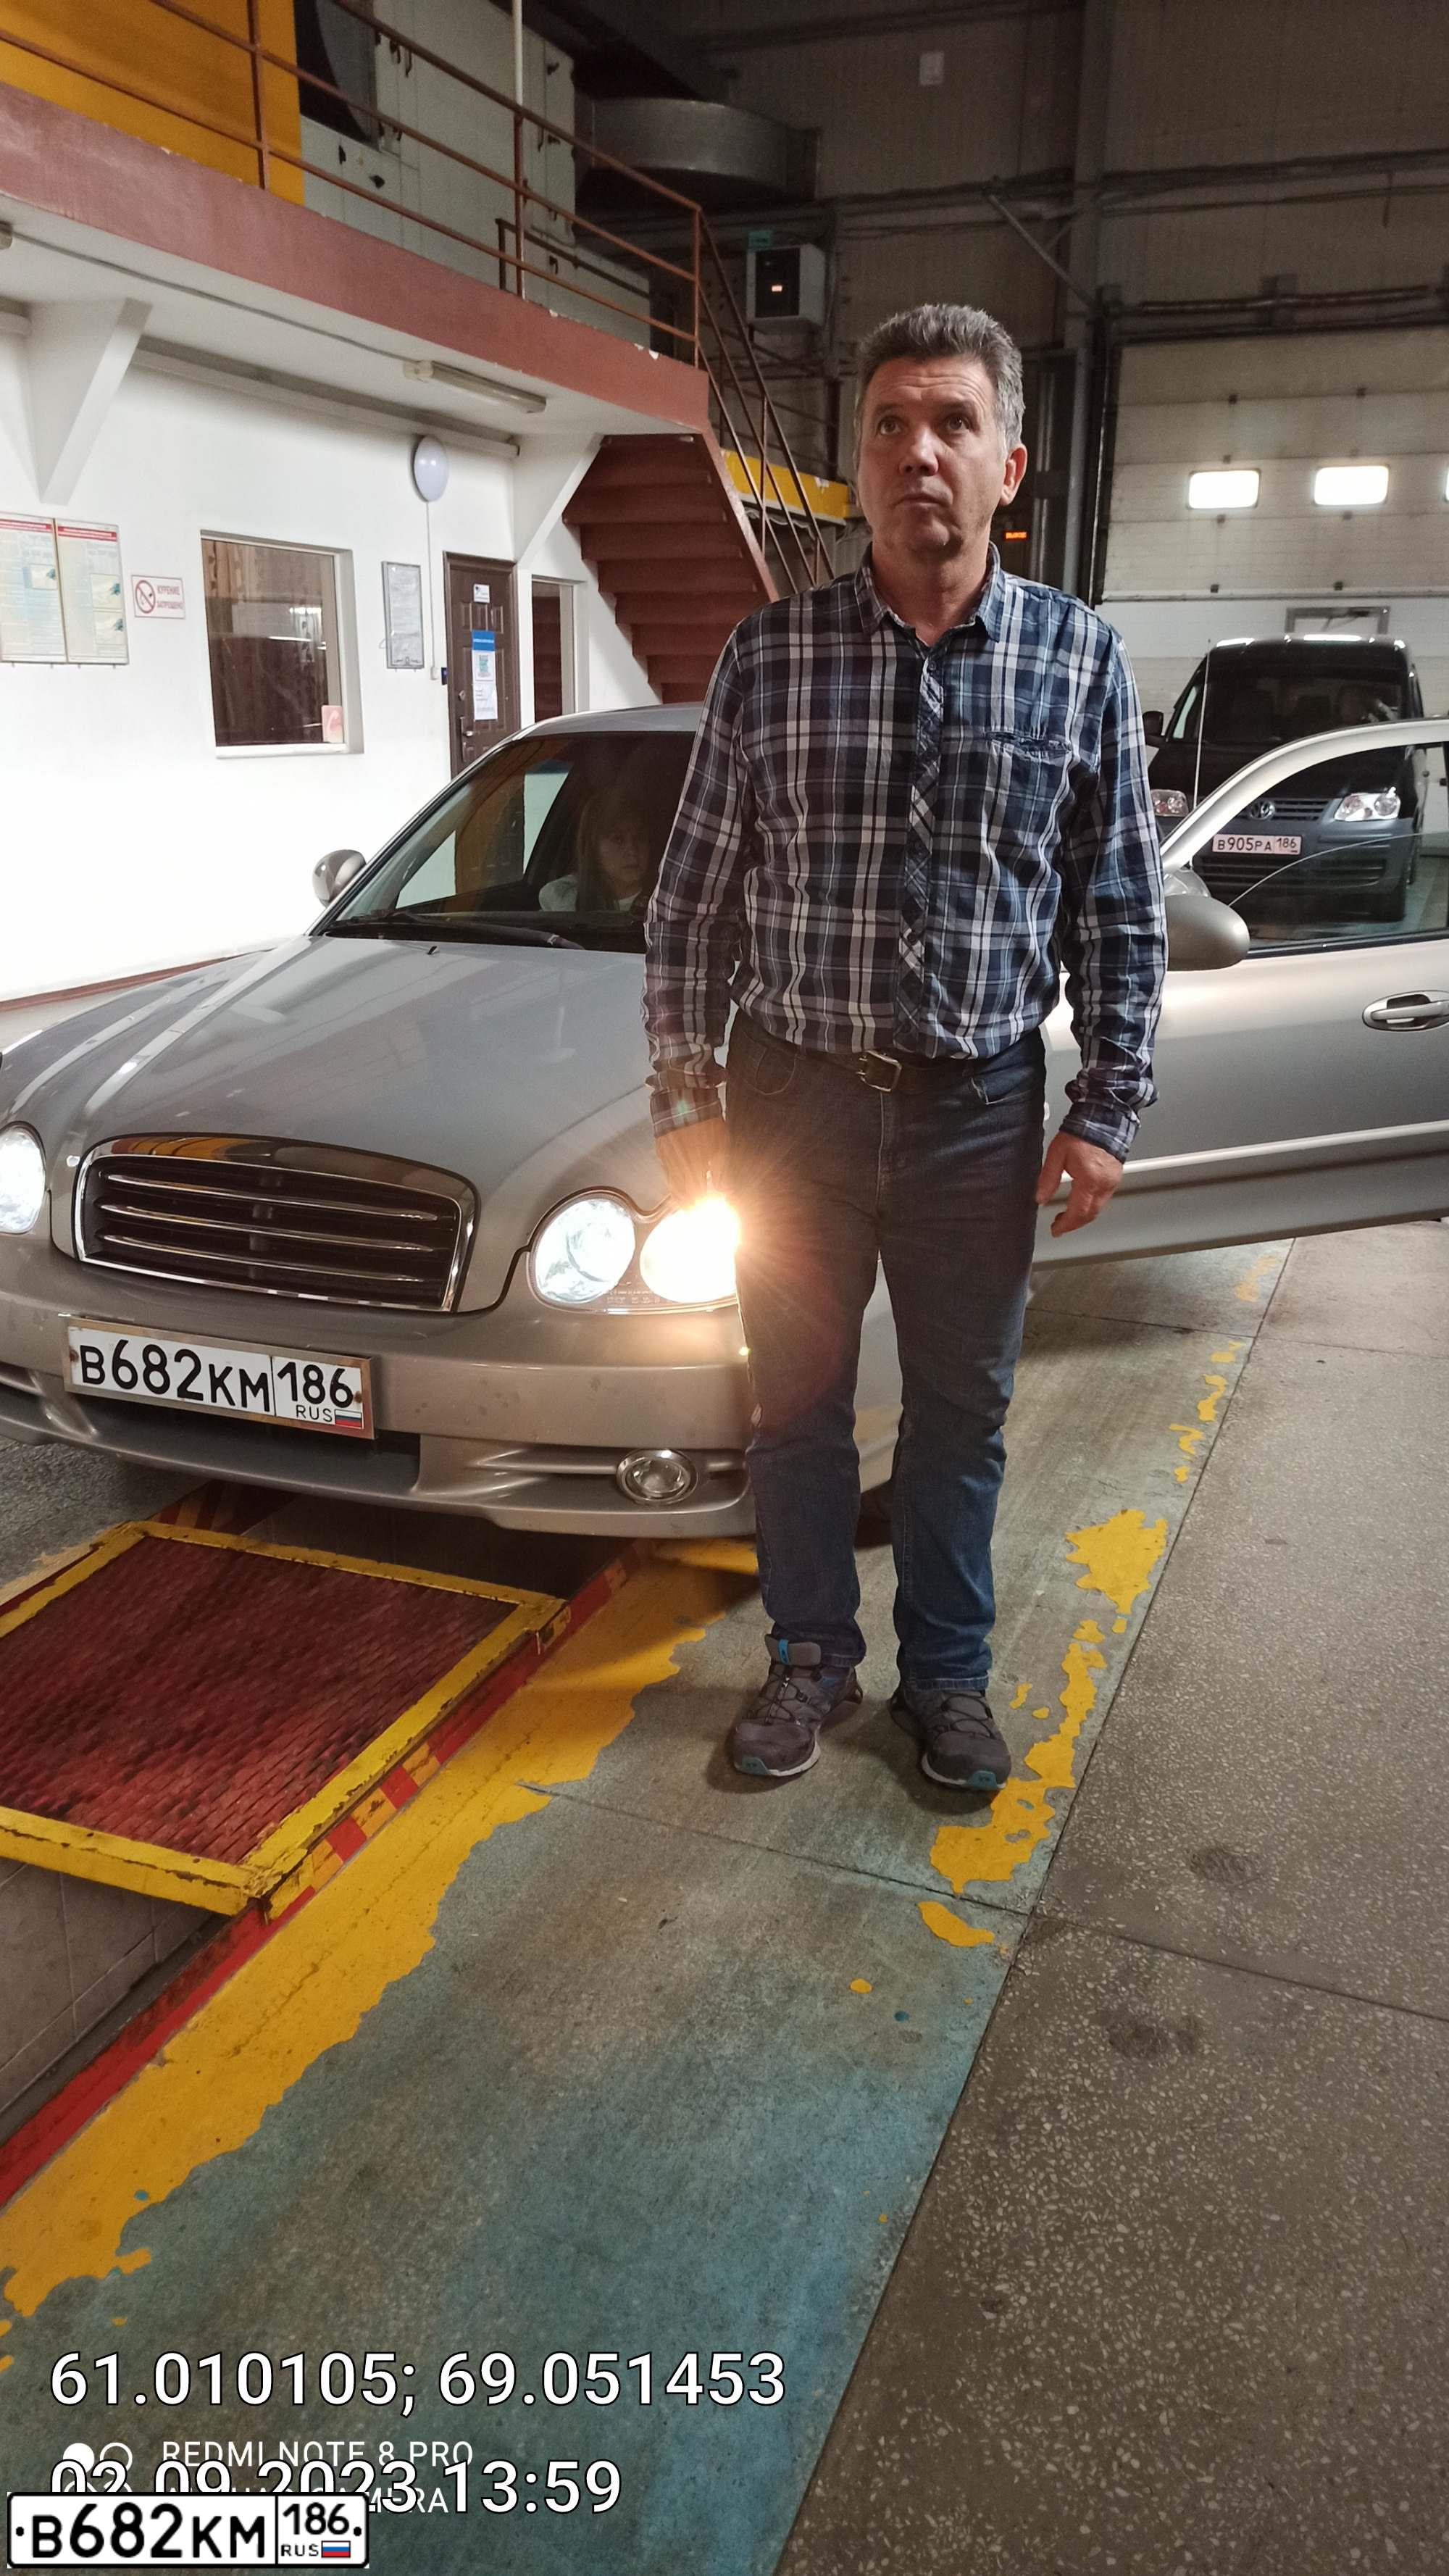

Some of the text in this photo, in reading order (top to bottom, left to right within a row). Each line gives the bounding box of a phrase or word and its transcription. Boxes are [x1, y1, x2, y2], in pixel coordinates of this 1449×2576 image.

[1218, 837, 1297, 851] В905РА 186
[80, 1339, 354, 1412] В682КМ 186
[296, 1405, 333, 1423] RUS
